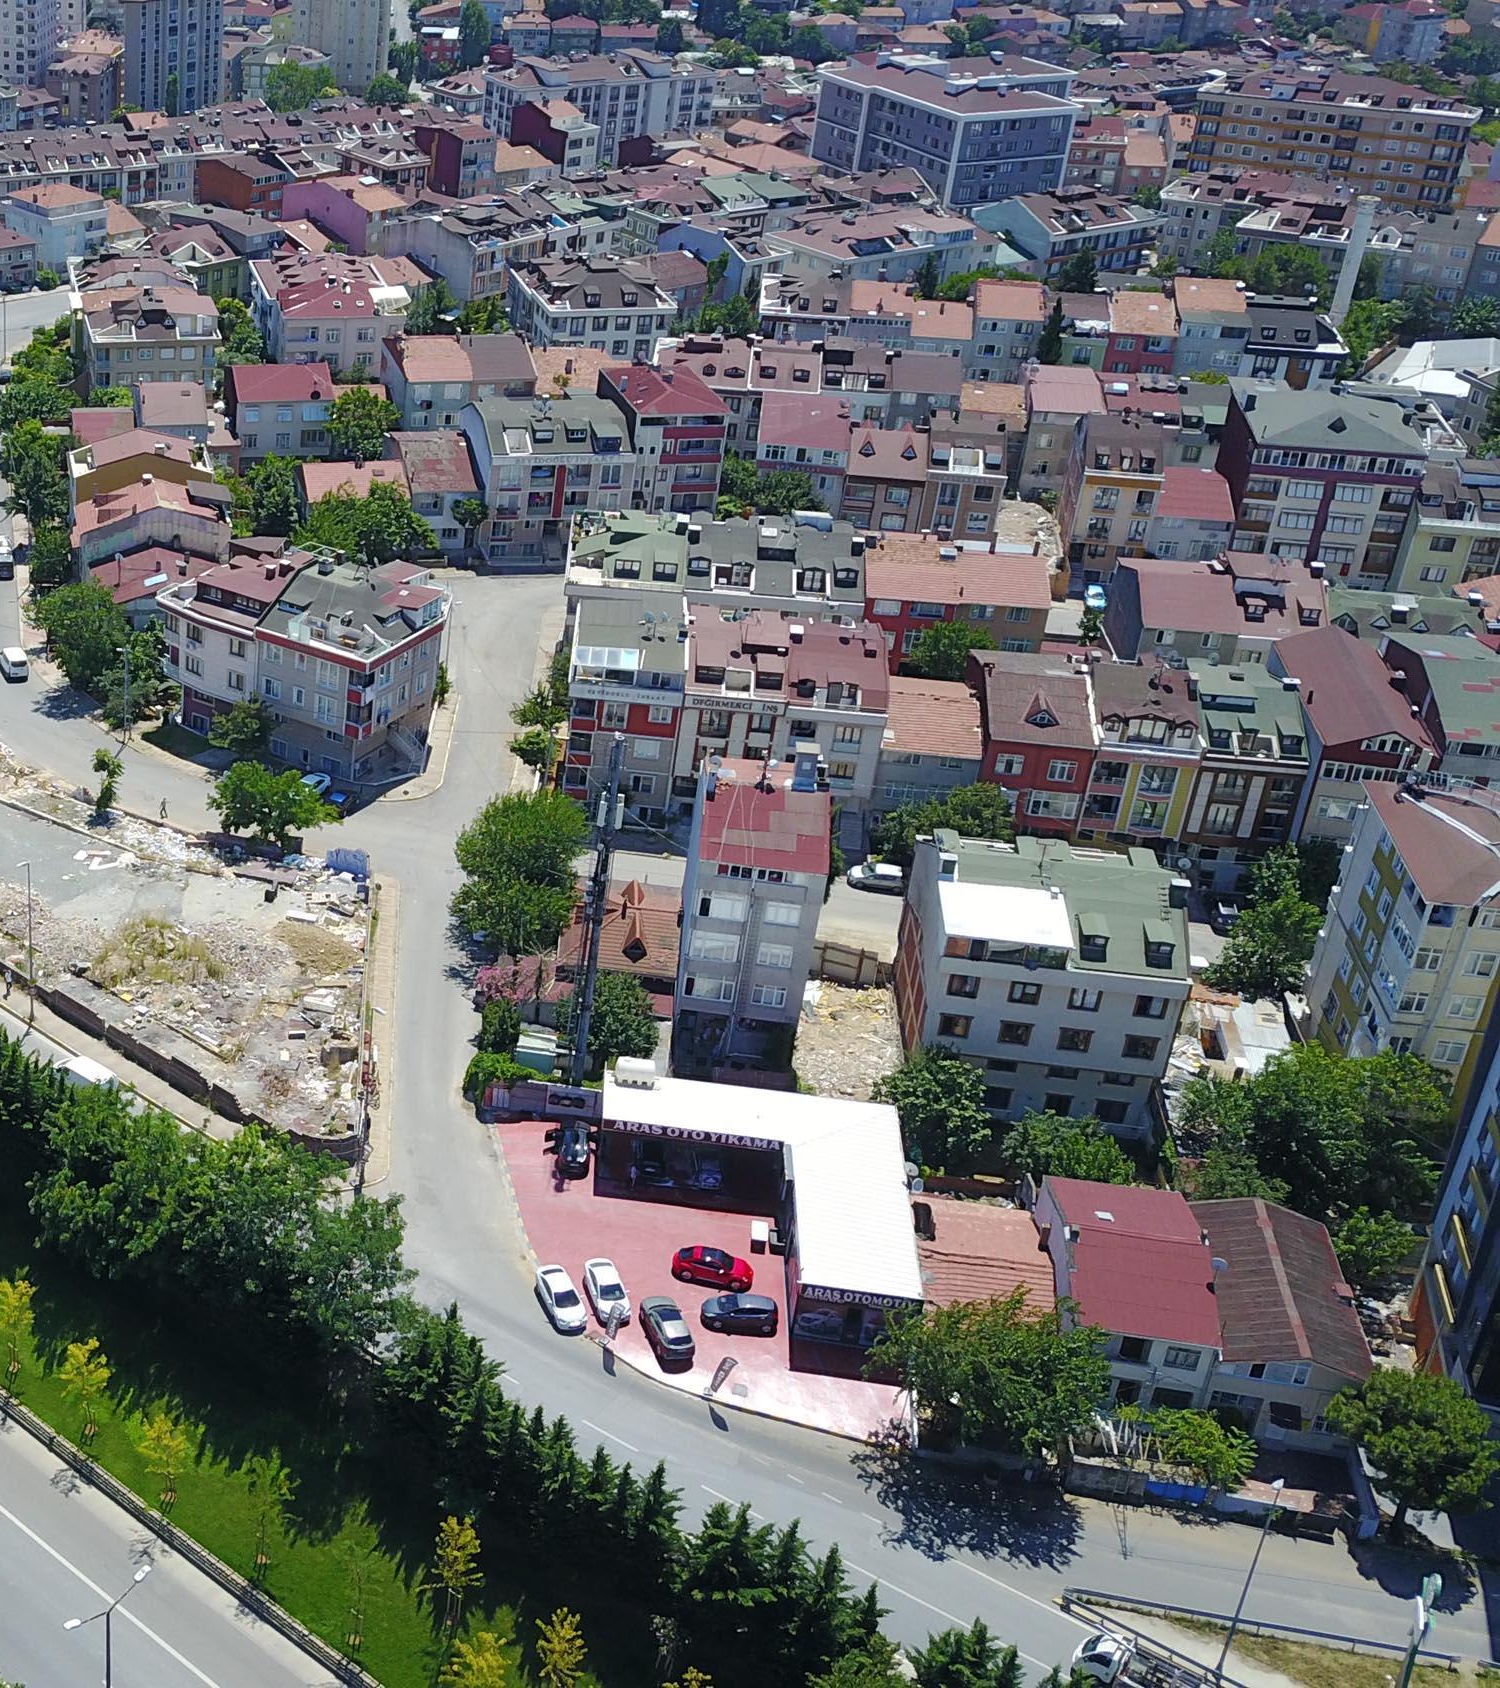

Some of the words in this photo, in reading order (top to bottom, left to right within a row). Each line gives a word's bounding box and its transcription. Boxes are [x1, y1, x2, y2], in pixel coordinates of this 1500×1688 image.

[613, 1120, 664, 1135] ARAS
[666, 1127, 705, 1140] OTO
[708, 1134, 780, 1150] YIKAMA
[804, 1287, 841, 1301] ARAS
